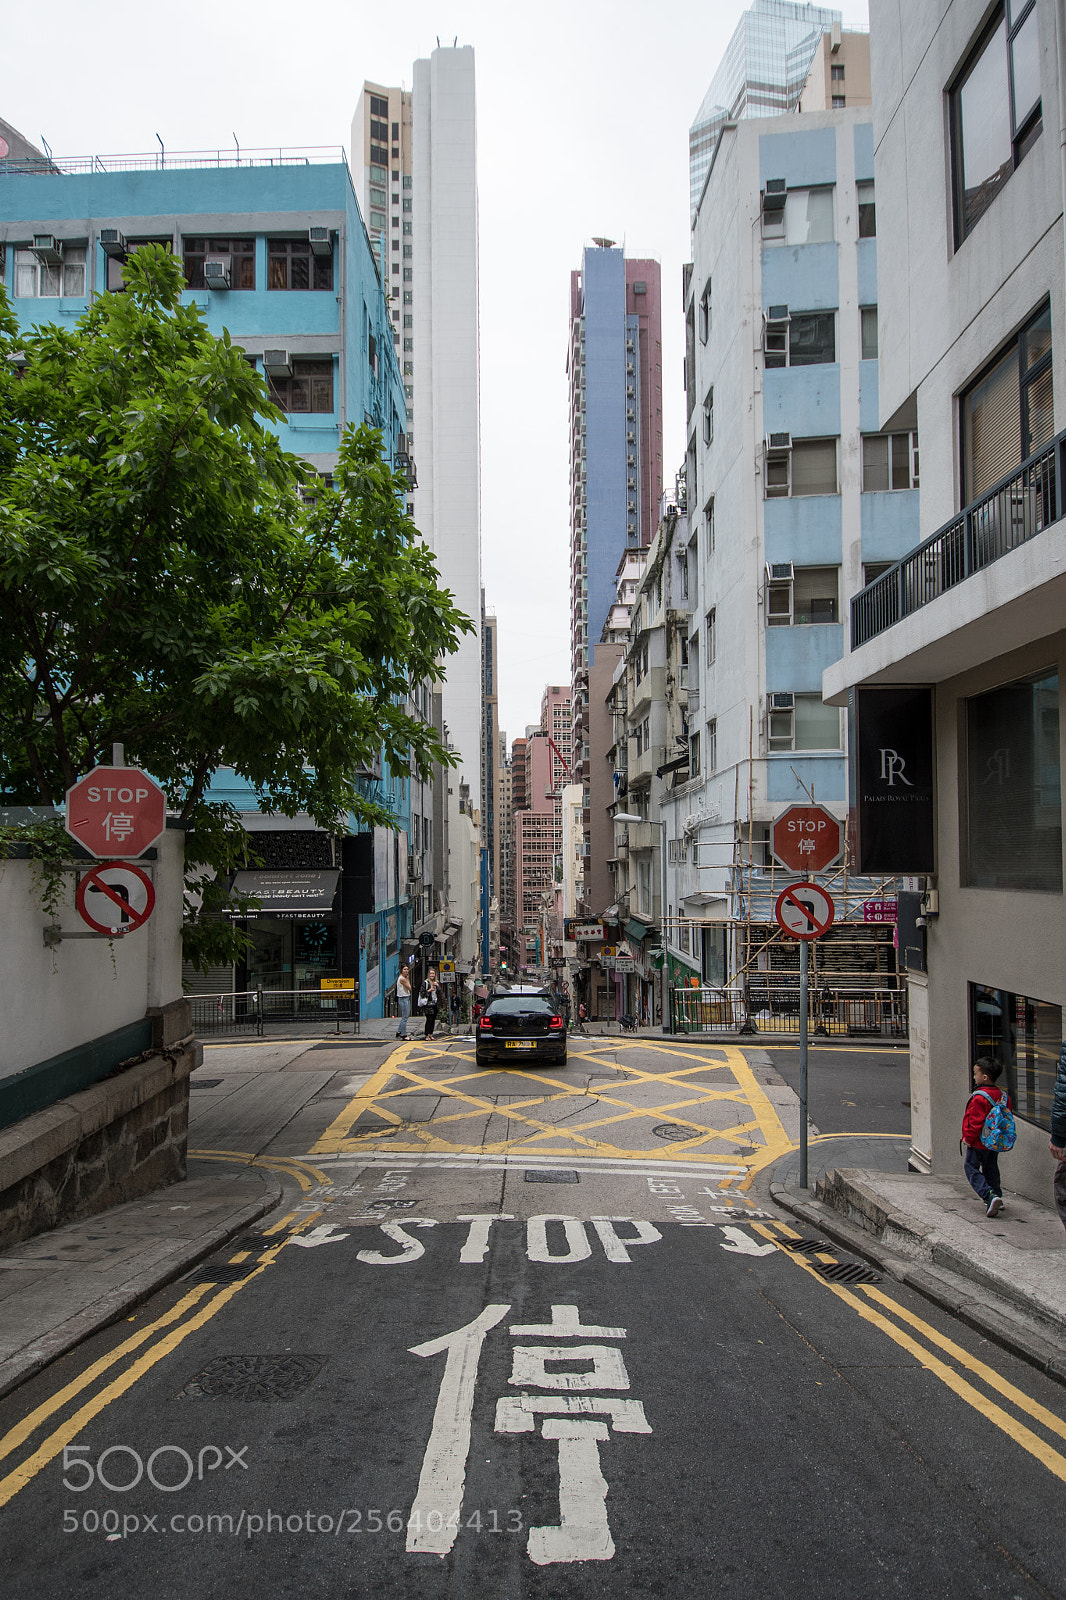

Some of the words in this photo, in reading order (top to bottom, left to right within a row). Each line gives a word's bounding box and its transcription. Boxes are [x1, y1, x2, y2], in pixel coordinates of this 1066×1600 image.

[87, 787, 149, 803] STOP
[102, 812, 134, 842] 停
[787, 820, 827, 833] STOP
[797, 838, 816, 855] 停
[647, 1177, 685, 1199] LEFT
[355, 1213, 663, 1265] STOP
[405, 1304, 653, 1566] 停
